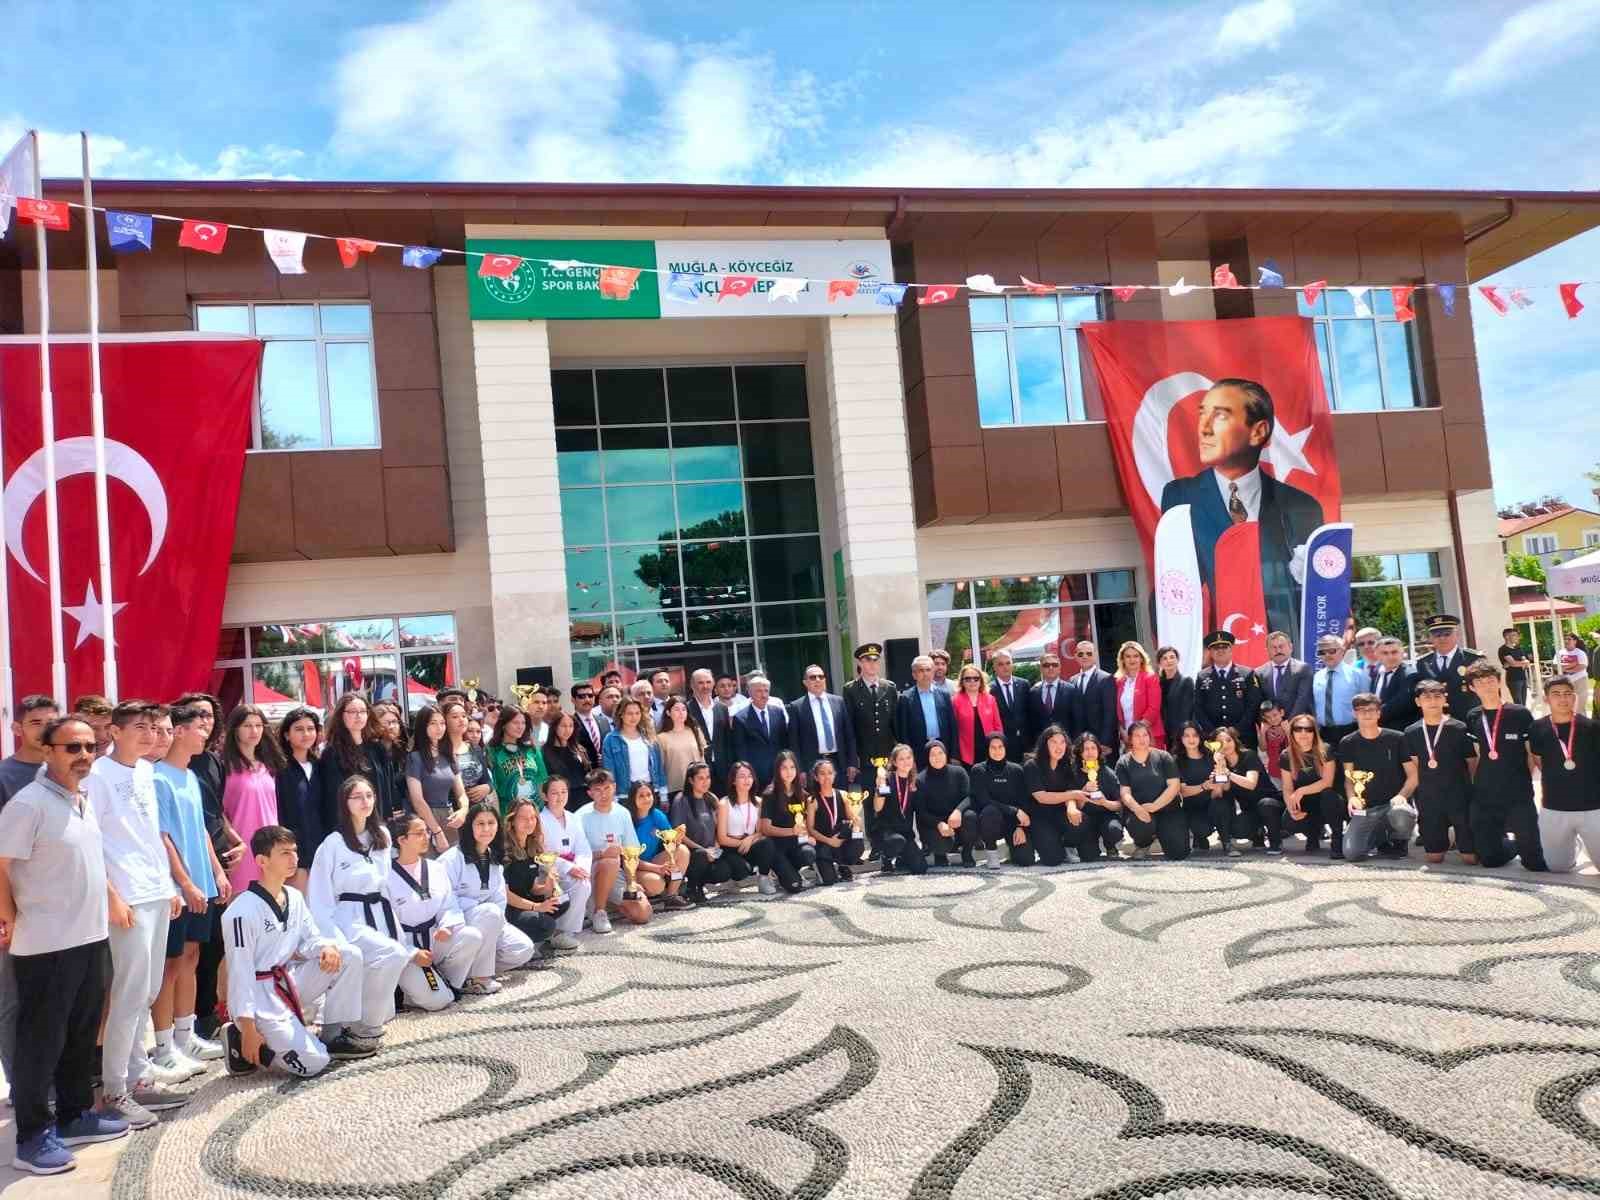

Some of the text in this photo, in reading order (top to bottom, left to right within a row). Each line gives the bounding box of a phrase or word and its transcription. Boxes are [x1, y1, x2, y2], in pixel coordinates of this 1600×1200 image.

[668, 261, 718, 273] MUĞLA
[728, 259, 794, 273] KÖYCEĞİZ
[542, 281, 573, 290] SPOR
